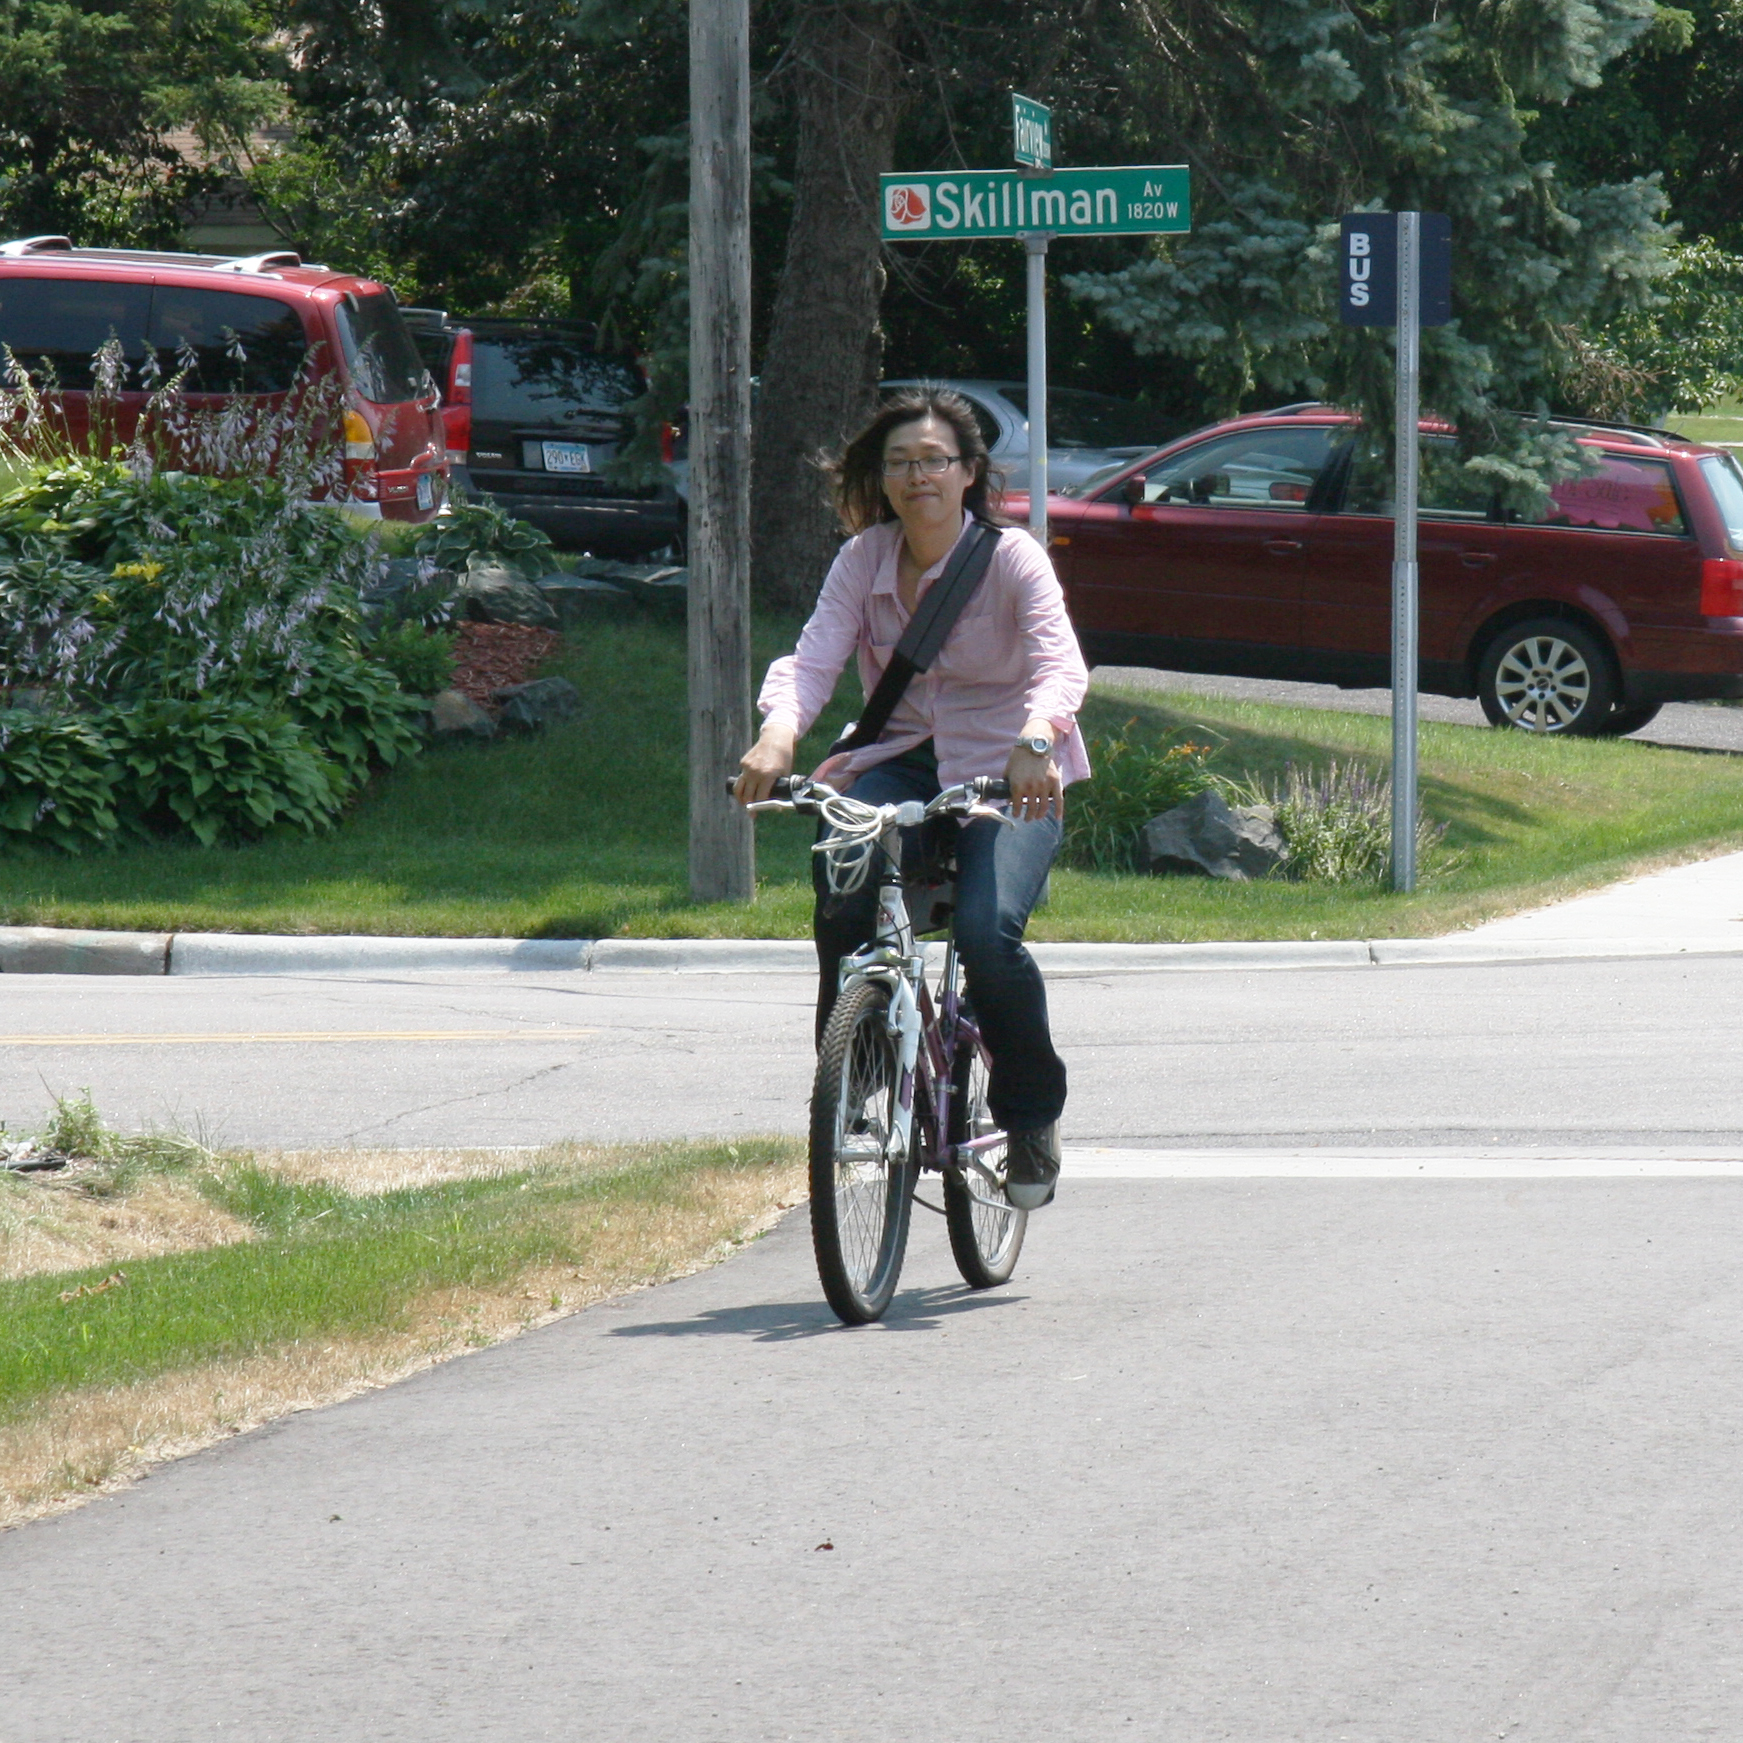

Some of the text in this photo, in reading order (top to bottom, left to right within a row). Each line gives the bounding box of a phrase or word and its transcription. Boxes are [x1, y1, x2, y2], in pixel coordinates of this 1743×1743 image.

[935, 181, 1118, 229] Skillman
[1143, 181, 1162, 197] Av
[1349, 232, 1371, 307] BUS
